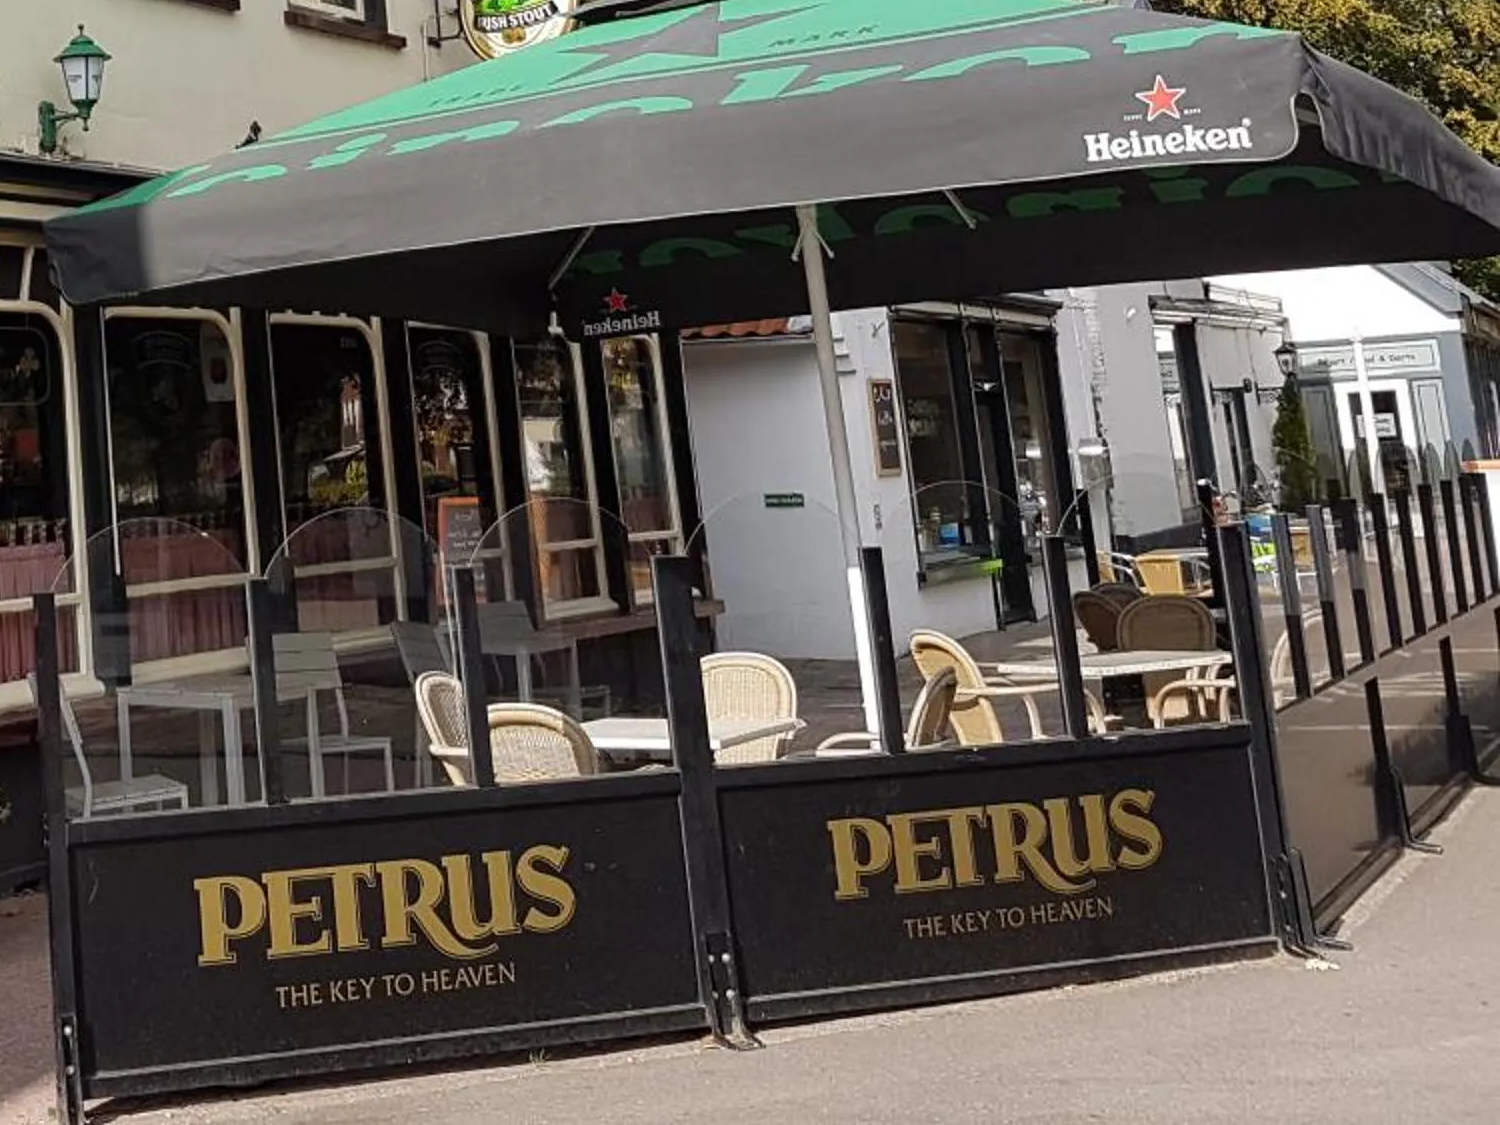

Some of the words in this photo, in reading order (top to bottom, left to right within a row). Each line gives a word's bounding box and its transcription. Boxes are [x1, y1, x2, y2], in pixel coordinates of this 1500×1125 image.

[508, 5, 552, 28] STOUT
[1083, 122, 1253, 162] Heineken
[827, 788, 1164, 900] PETRUS
[193, 843, 577, 967] PETRUS
[903, 916, 947, 939] THE
[951, 910, 992, 934] KEY
[995, 906, 1025, 929] TO
[1030, 896, 1114, 924] HEAVEN
[275, 983, 324, 1009] THE
[329, 977, 375, 1004] KEY
[381, 974, 415, 997] TO
[421, 961, 517, 993] HEAVEN
